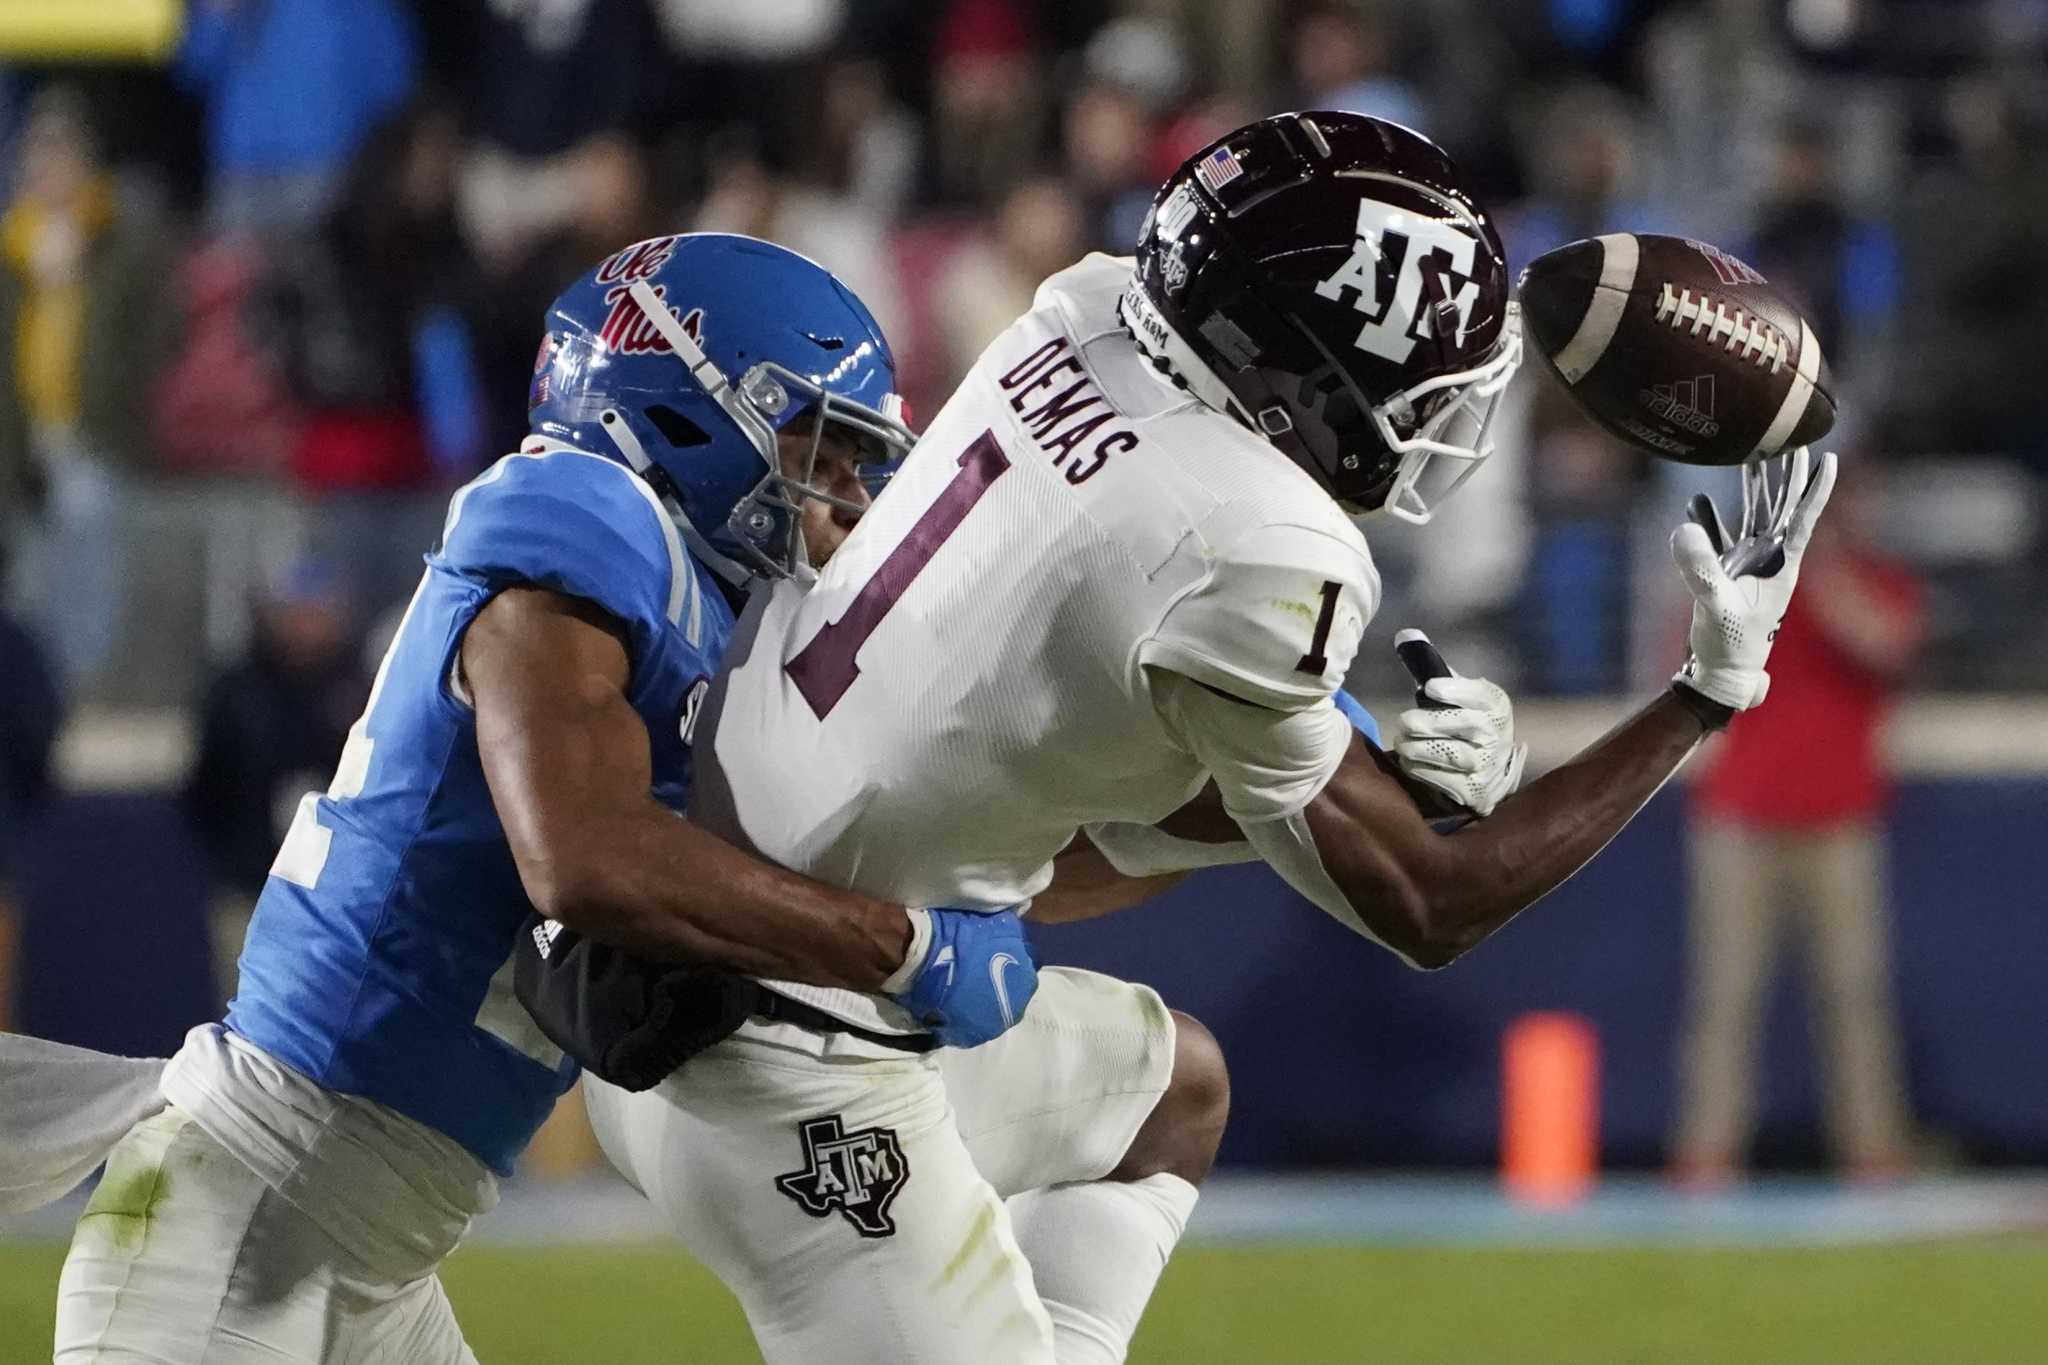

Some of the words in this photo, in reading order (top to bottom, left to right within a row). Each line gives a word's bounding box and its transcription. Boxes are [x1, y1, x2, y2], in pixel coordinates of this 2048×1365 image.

[998, 336, 1140, 485] DEMAS
[784, 428, 1011, 722] 1
[1295, 580, 1343, 675] 1
